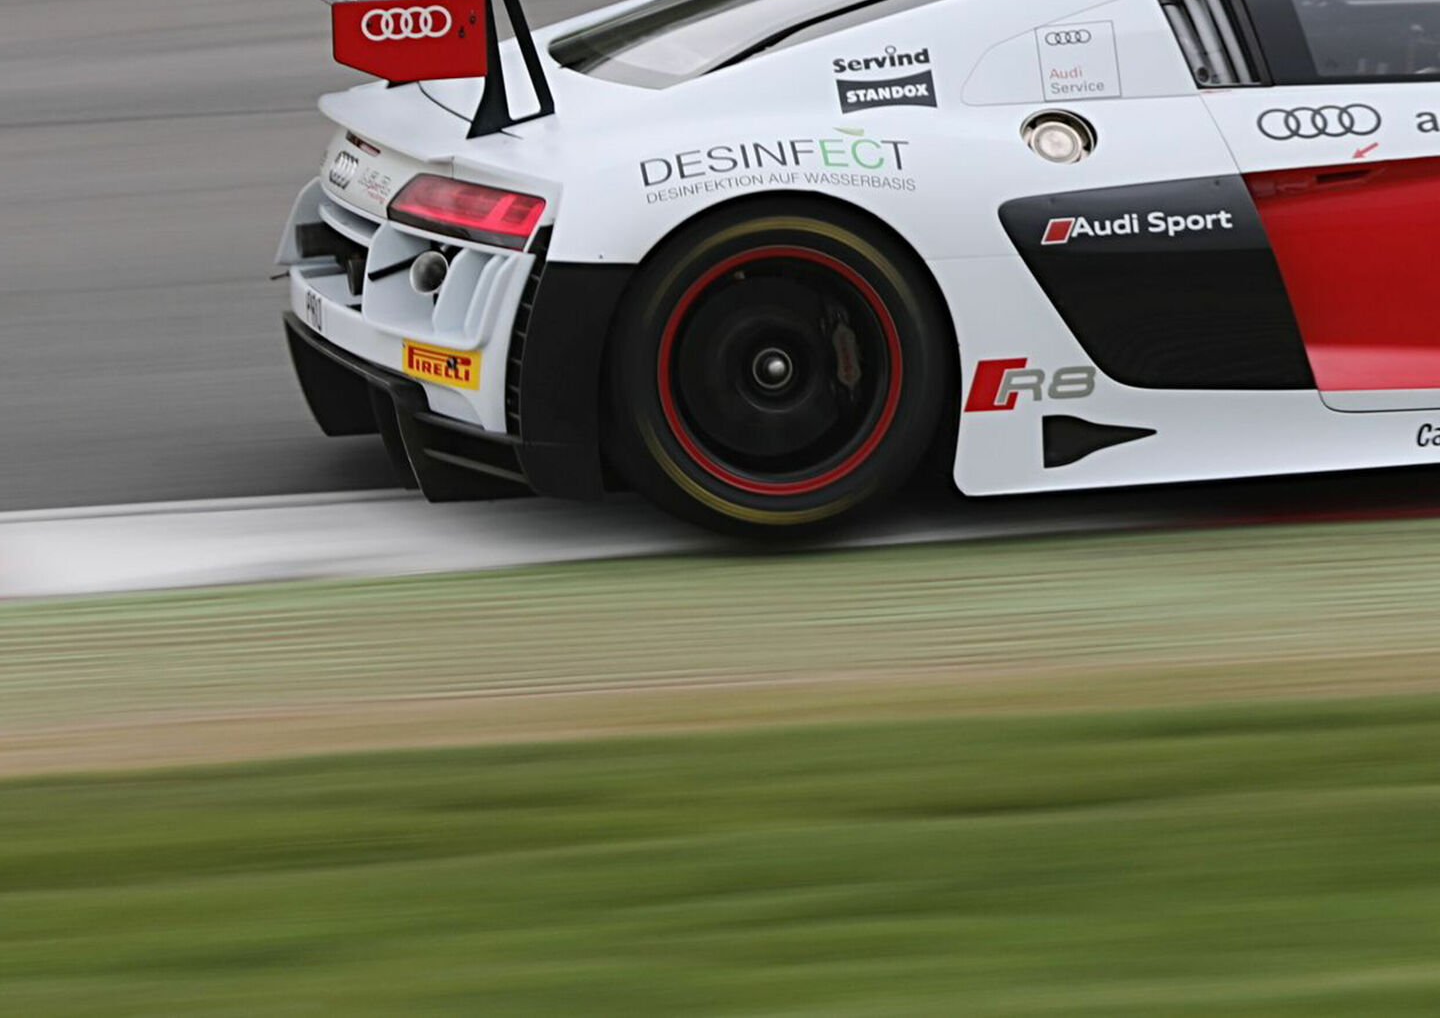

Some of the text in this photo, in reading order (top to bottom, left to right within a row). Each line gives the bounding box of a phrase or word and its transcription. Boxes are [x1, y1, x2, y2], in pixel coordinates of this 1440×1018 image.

[833, 45, 930, 73] Servind
[1049, 68, 1082, 80] Audi
[846, 83, 928, 104] STANDOX
[1050, 82, 1105, 95] Service
[639, 138, 910, 187] DESINFECT
[646, 171, 917, 204] DESINFEKTION AUF WASSERBASIS
[1071, 211, 1233, 237] Audi Sport
[407, 345, 472, 382] PIRELLI
[992, 365, 1097, 405] R8
